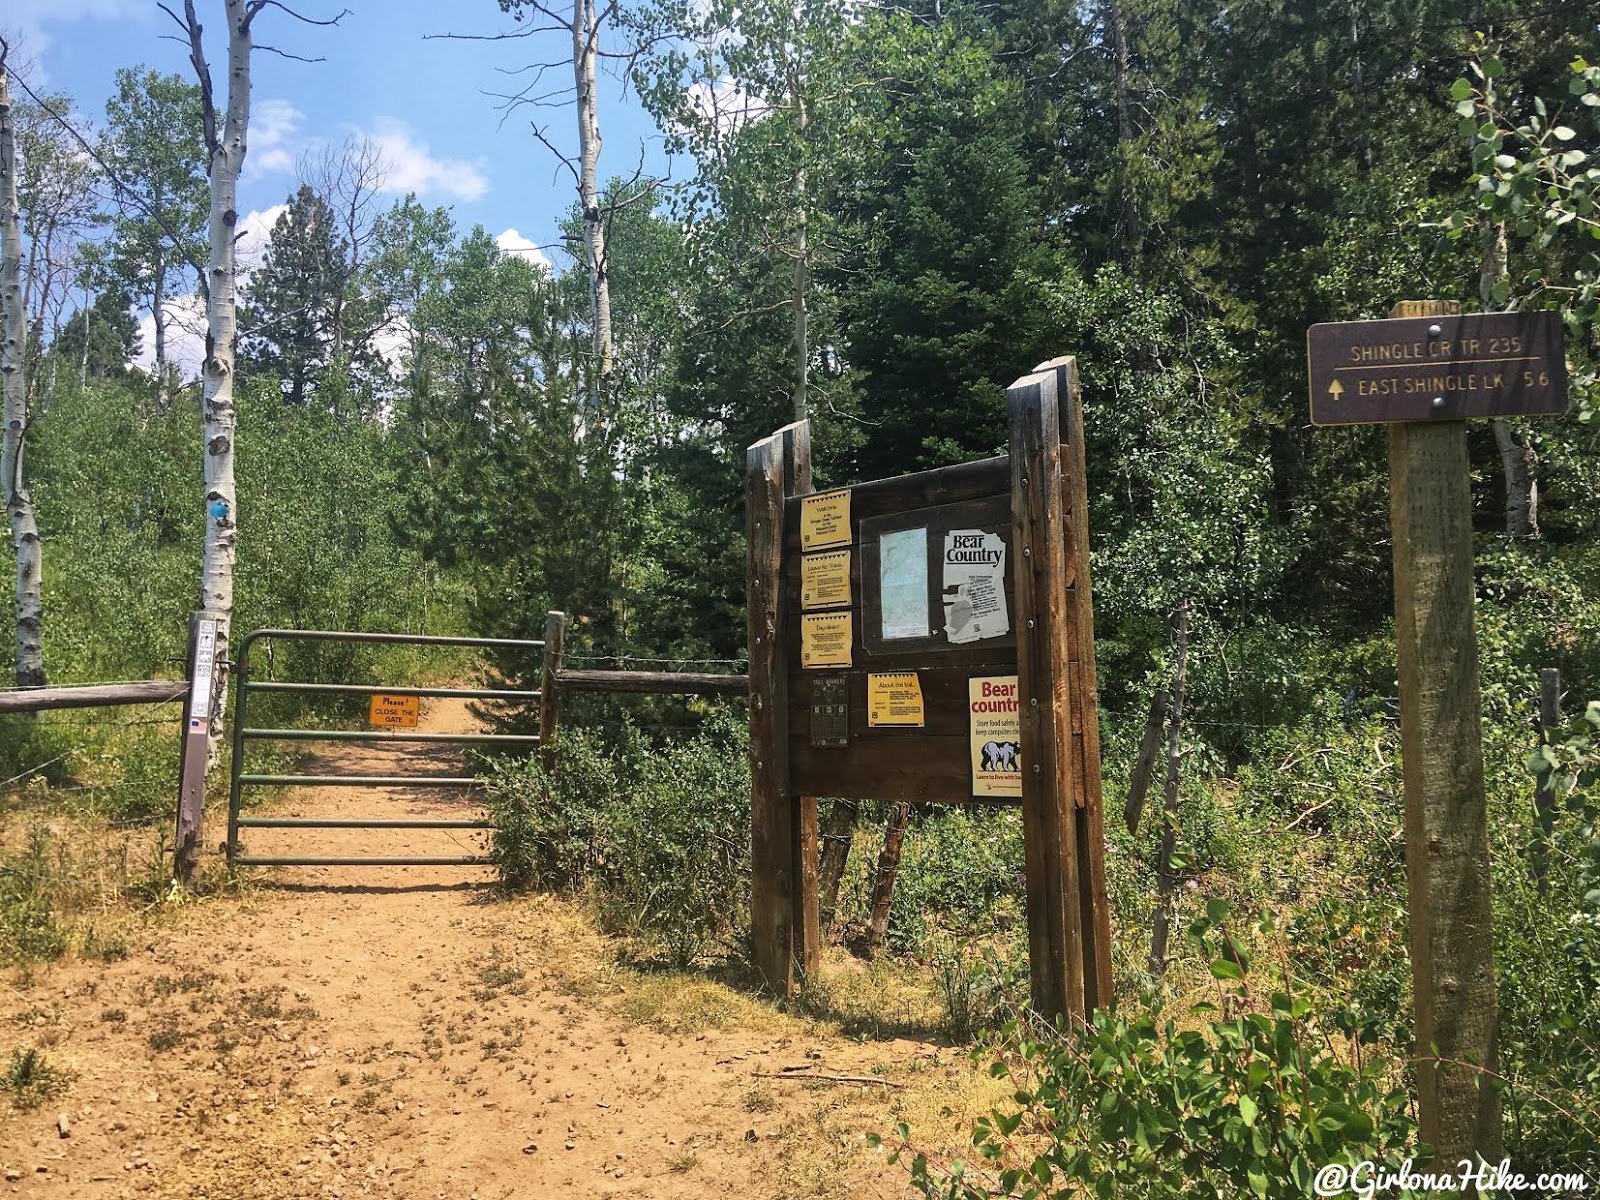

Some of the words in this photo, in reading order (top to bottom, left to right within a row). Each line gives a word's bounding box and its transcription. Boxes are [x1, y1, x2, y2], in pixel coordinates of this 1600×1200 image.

[1350, 341, 1422, 362] SHINGLE
[1429, 341, 1452, 357] CR
[1461, 339, 1480, 355] TR
[1489, 337, 1522, 354] 235
[1357, 378, 1399, 396] EAST
[1404, 374, 1477, 393] SHINGLE
[1483, 374, 1504, 389] LK
[953, 534, 985, 549] Bear
[946, 548, 1003, 568] Country
[981, 681, 1016, 698] Bear
[971, 697, 1019, 713] countr
[976, 719, 989, 727] Store
[989, 719, 1001, 727] food
[976, 728, 988, 737] keep
[988, 728, 1012, 738] campsites
